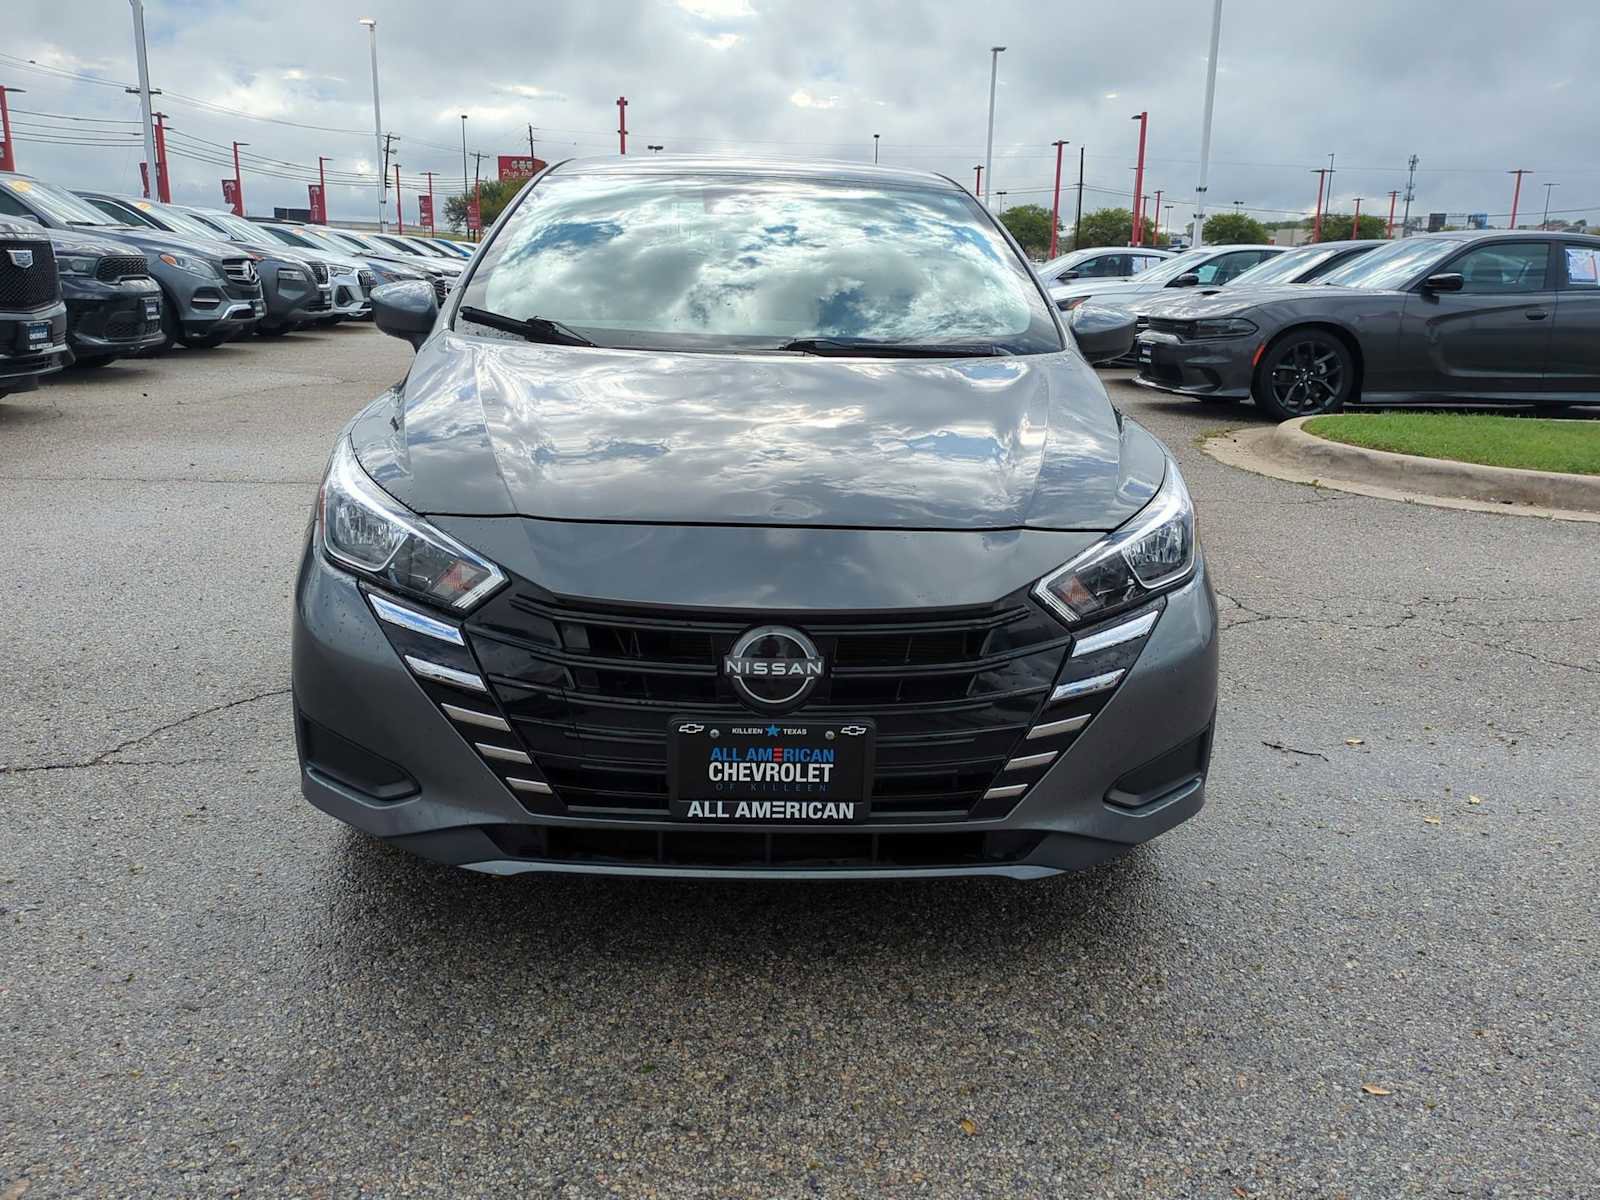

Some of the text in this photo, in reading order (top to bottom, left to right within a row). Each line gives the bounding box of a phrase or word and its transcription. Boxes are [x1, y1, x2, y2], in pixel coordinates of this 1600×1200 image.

[726, 660, 823, 676] NISSAN
[731, 727, 807, 736] KILLEEN TEXAS
[710, 747, 834, 763] ALL AMERICAN
[708, 762, 834, 783] CHEVROLET
[715, 783, 828, 792] OF KILLEEN
[688, 801, 854, 820] ALL AMERICAN
